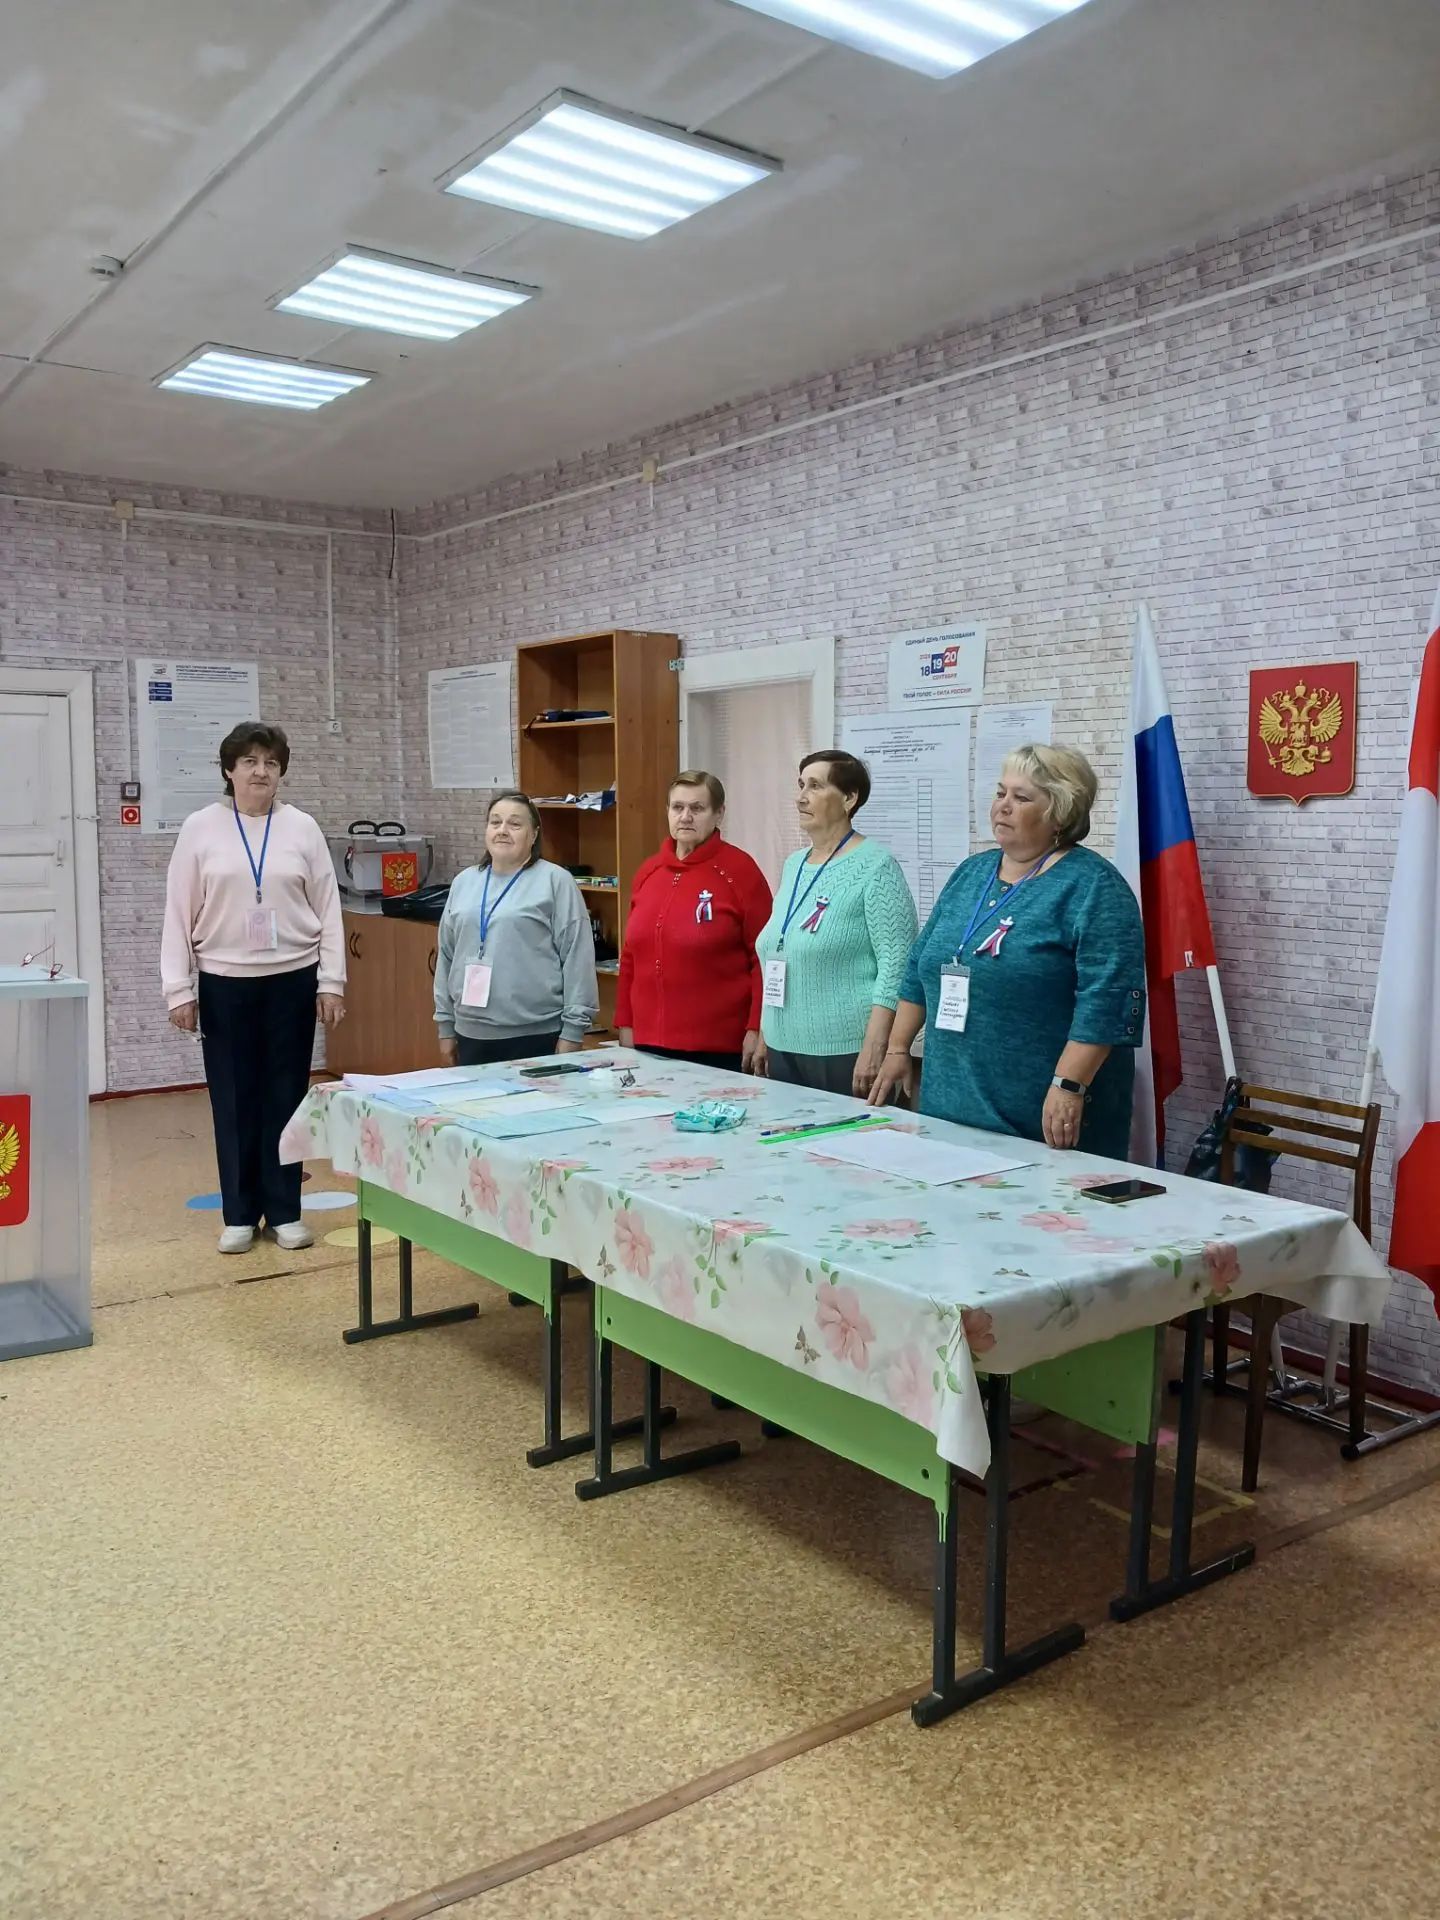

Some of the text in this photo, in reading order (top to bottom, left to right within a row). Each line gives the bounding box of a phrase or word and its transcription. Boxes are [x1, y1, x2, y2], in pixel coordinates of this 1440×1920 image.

[939, 632, 976, 640] ГОЛОСОВАНИЯ
[920, 666, 930, 676] 18
[932, 658, 943, 670] 19
[944, 651, 957, 663] 20
